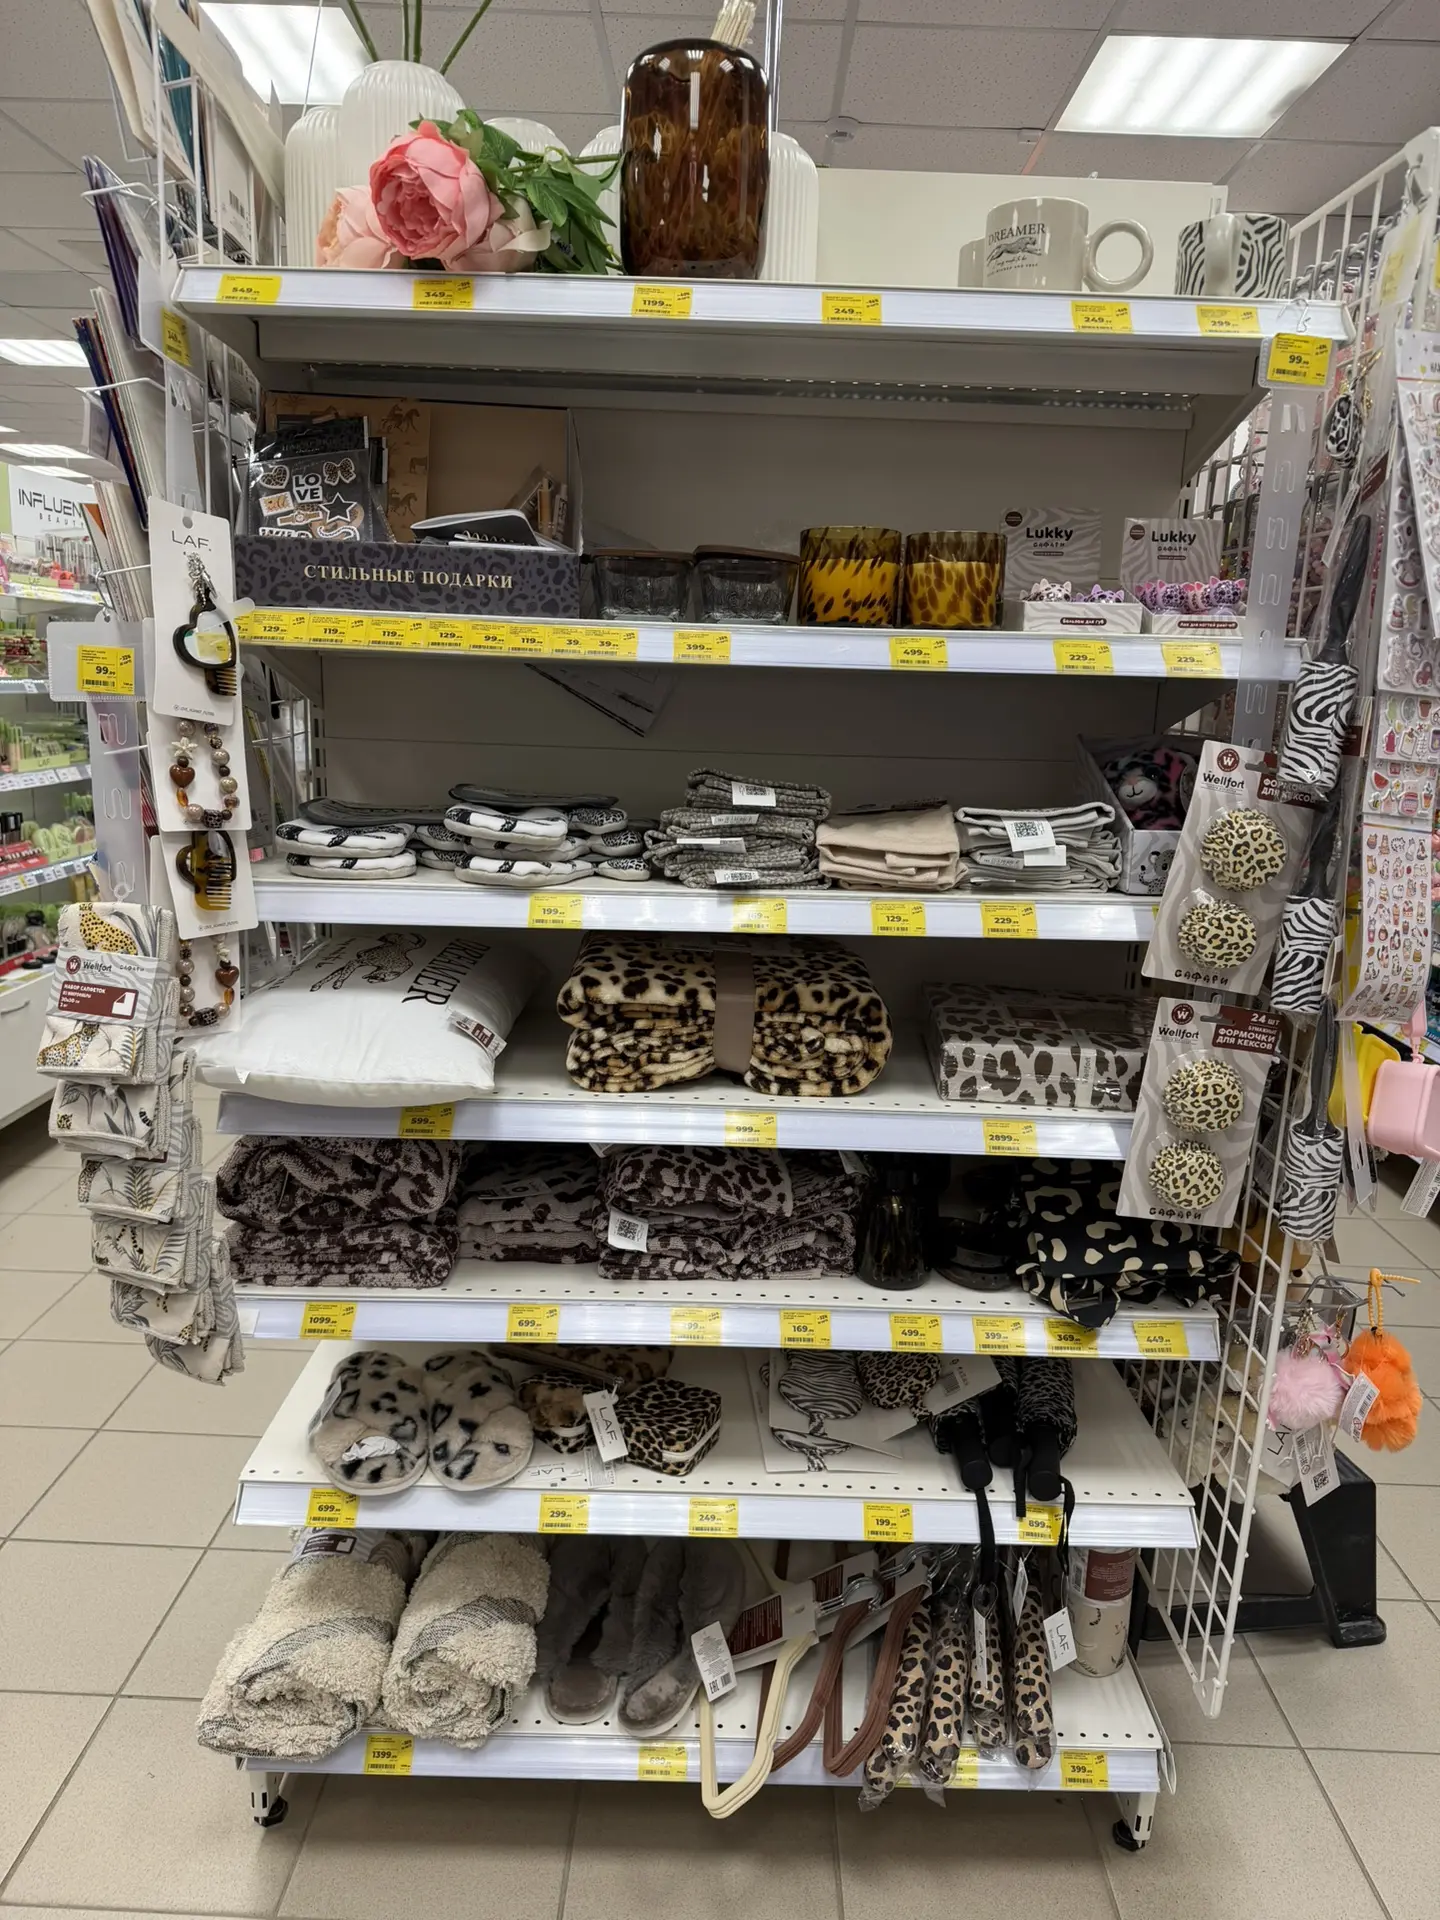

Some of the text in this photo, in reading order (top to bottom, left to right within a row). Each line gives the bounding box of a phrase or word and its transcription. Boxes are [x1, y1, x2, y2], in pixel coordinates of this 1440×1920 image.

[988, 221, 1046, 246] DREAMER
[1026, 526, 1074, 541] Lukky
[1151, 530, 1197, 546] Lukky
[303, 564, 514, 590] СТИЛЬНЫЕ ПОДАРКИ
[1203, 771, 1245, 789] Wellfort
[83, 961, 112, 973] Wellfort
[401, 938, 491, 1006] DREAMER
[1174, 969, 1229, 986] САФАРИ
[1251, 1013, 1266, 1024] 24
[1158, 1024, 1200, 1040] Wellfort
[1218, 1028, 1276, 1043] ФОРМОЧКИ
[1216, 1036, 1273, 1050] ДЛЯ КЕКСОВ
[1149, 1207, 1203, 1220] САФАРИ
